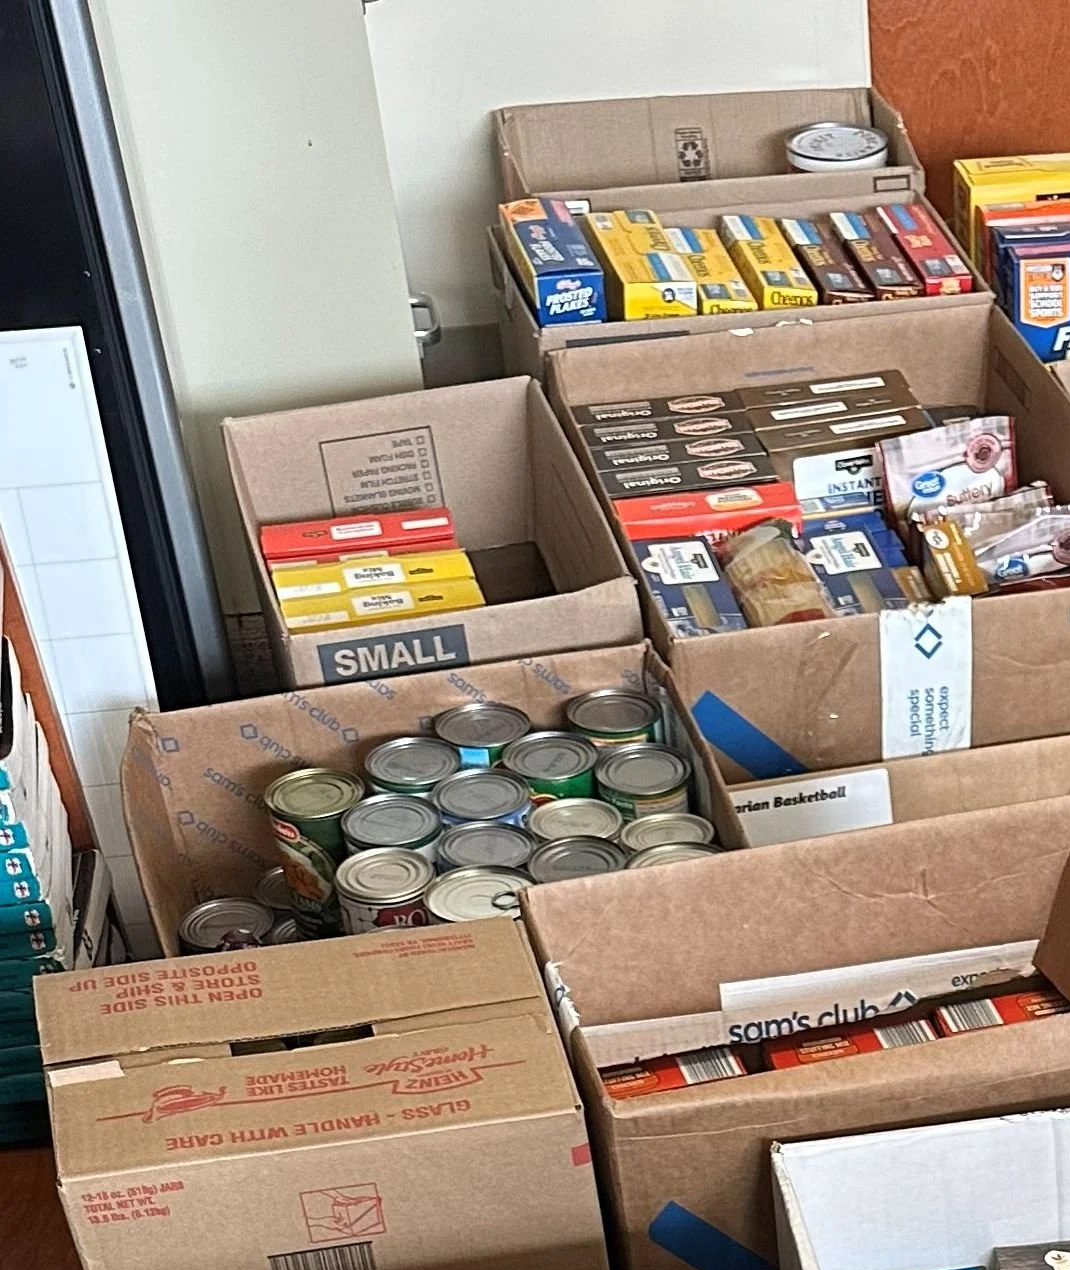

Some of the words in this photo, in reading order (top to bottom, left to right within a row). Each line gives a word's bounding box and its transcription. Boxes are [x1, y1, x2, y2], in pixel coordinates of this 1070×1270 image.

[334, 635, 456, 677] SMALL
[909, 689, 922, 737] special
[938, 685, 950, 732] expect
[773, 786, 847, 808] Basketball
[103, 972, 152, 988] SIDE
[154, 961, 258, 982] OPPOSITE
[68, 978, 100, 993] UP
[115, 983, 165, 999] SHIP
[169, 981, 187, 994] &
[192, 975, 261, 992] STORE
[155, 993, 201, 1007] THIS
[203, 986, 263, 1001] OPEN
[99, 999, 149, 1015] SIDE
[729, 1009, 812, 1043] sam's
[245, 1064, 348, 1086] HOMEMADE
[286, 1075, 350, 1093] TASTES
[406, 1069, 468, 1091] HEINZ
[246, 1081, 283, 1097] LIKE
[401, 1099, 471, 1121] GLASS
[229, 1124, 289, 1143] WITH
[294, 1112, 381, 1137] HANDLE
[165, 1133, 223, 1151] CARE
